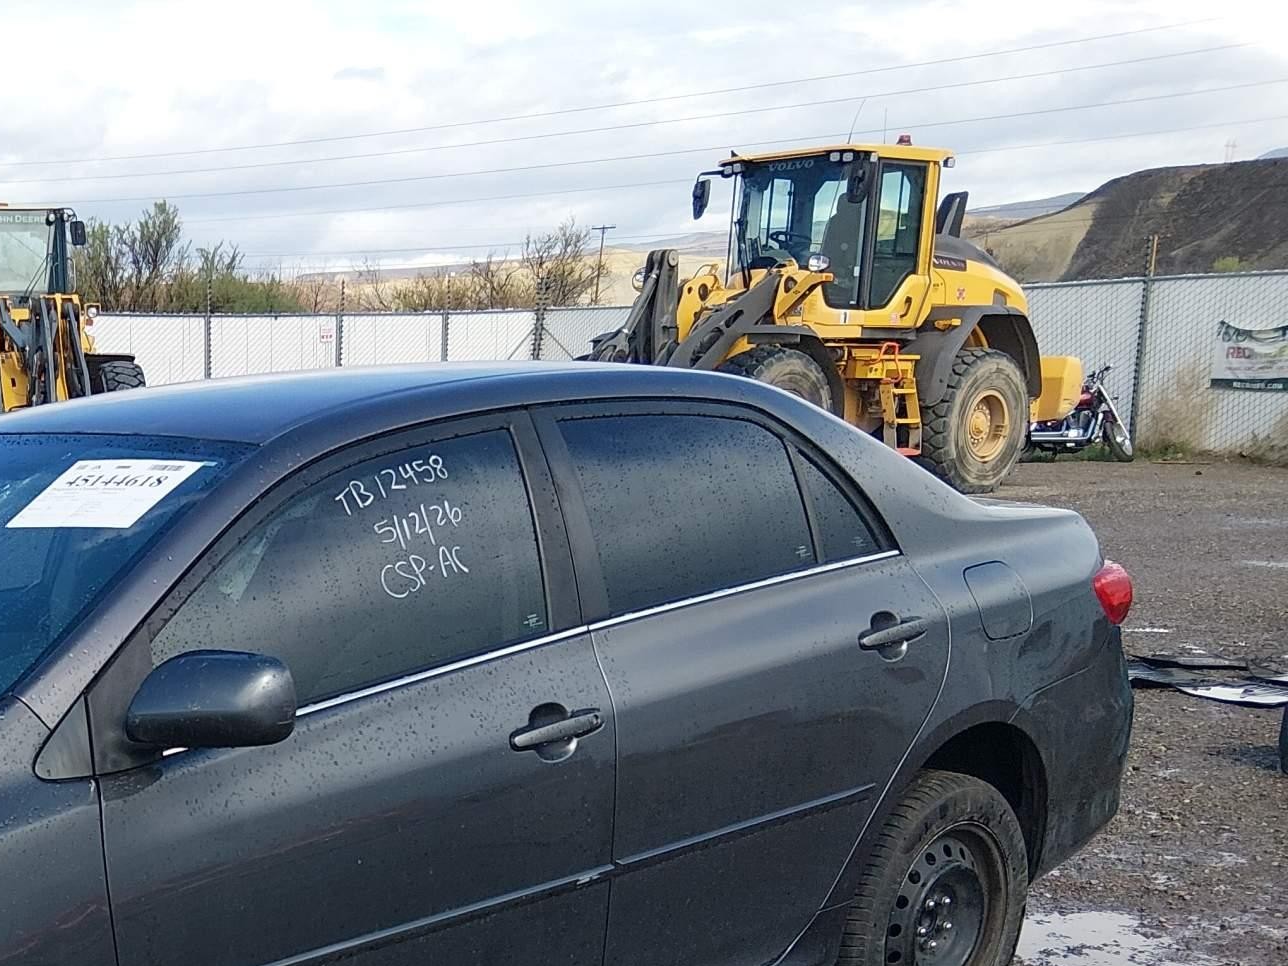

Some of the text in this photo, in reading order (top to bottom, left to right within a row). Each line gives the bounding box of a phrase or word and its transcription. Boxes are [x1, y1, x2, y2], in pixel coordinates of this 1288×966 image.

[768, 159, 814, 171] VOLVO
[65, 474, 169, 488] 45144618
[335, 455, 448, 516] TB12458
[373, 500, 463, 550] 5/12/26
